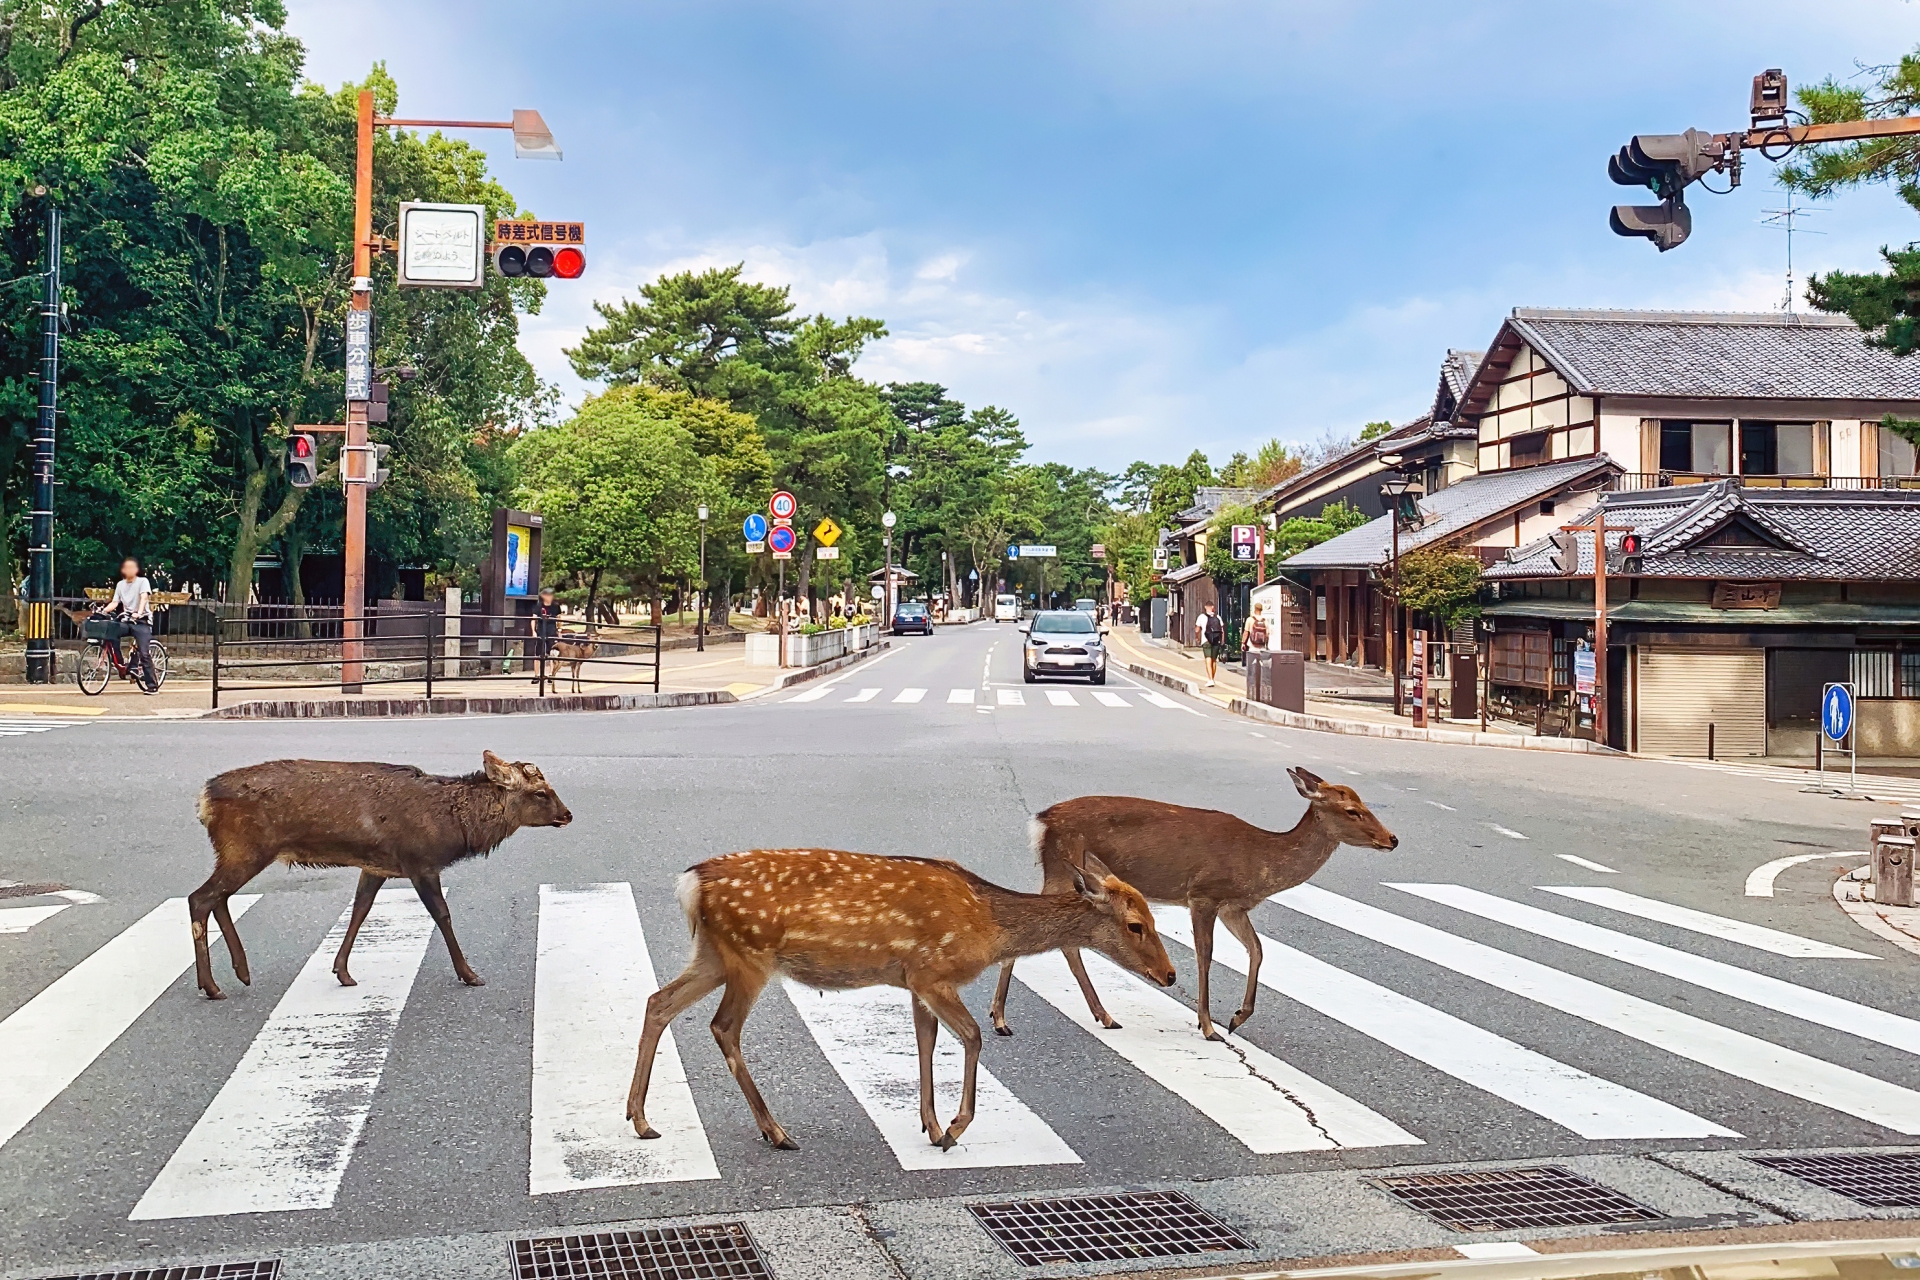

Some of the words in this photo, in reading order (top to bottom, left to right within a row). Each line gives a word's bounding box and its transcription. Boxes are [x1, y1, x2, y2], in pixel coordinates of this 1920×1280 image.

[498, 223, 582, 241] 時差式信号機
[348, 313, 367, 398] 歩車分離式
[776, 499, 790, 512] 40
[1237, 527, 1251, 543] P
[1156, 550, 1165, 560] P
